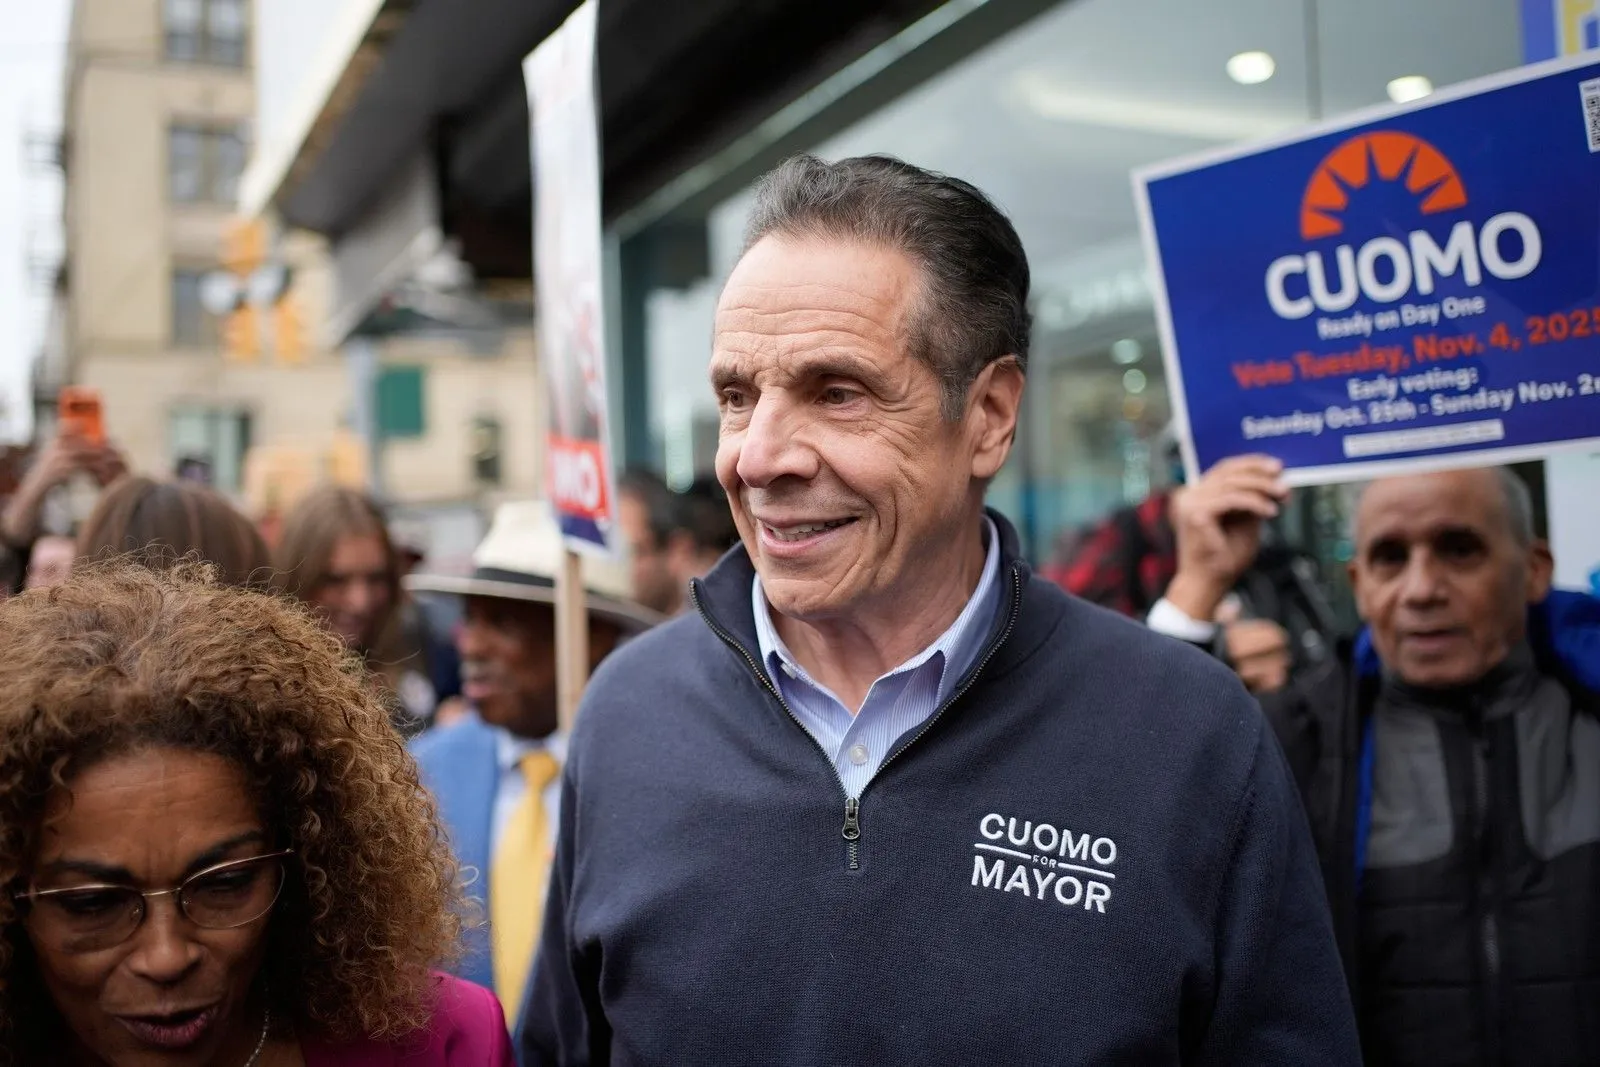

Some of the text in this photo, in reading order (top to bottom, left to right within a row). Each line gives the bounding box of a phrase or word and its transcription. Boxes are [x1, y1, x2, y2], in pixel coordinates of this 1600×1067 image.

[1265, 211, 1543, 319] CUOMO
[1316, 296, 1486, 340] Ready on Day One
[1232, 360, 1293, 388] Vote
[1413, 334, 1485, 363] Nov.
[1489, 321, 1521, 352] 4,
[1241, 409, 1324, 440] Saturday
[1430, 386, 1514, 416] Sunday
[1518, 380, 1574, 404] Nov.
[1347, 366, 1479, 402] Early voting:
[979, 812, 1118, 865] CUOMO
[1032, 854, 1057, 869] FOR
[971, 855, 1112, 914] MAYOR
